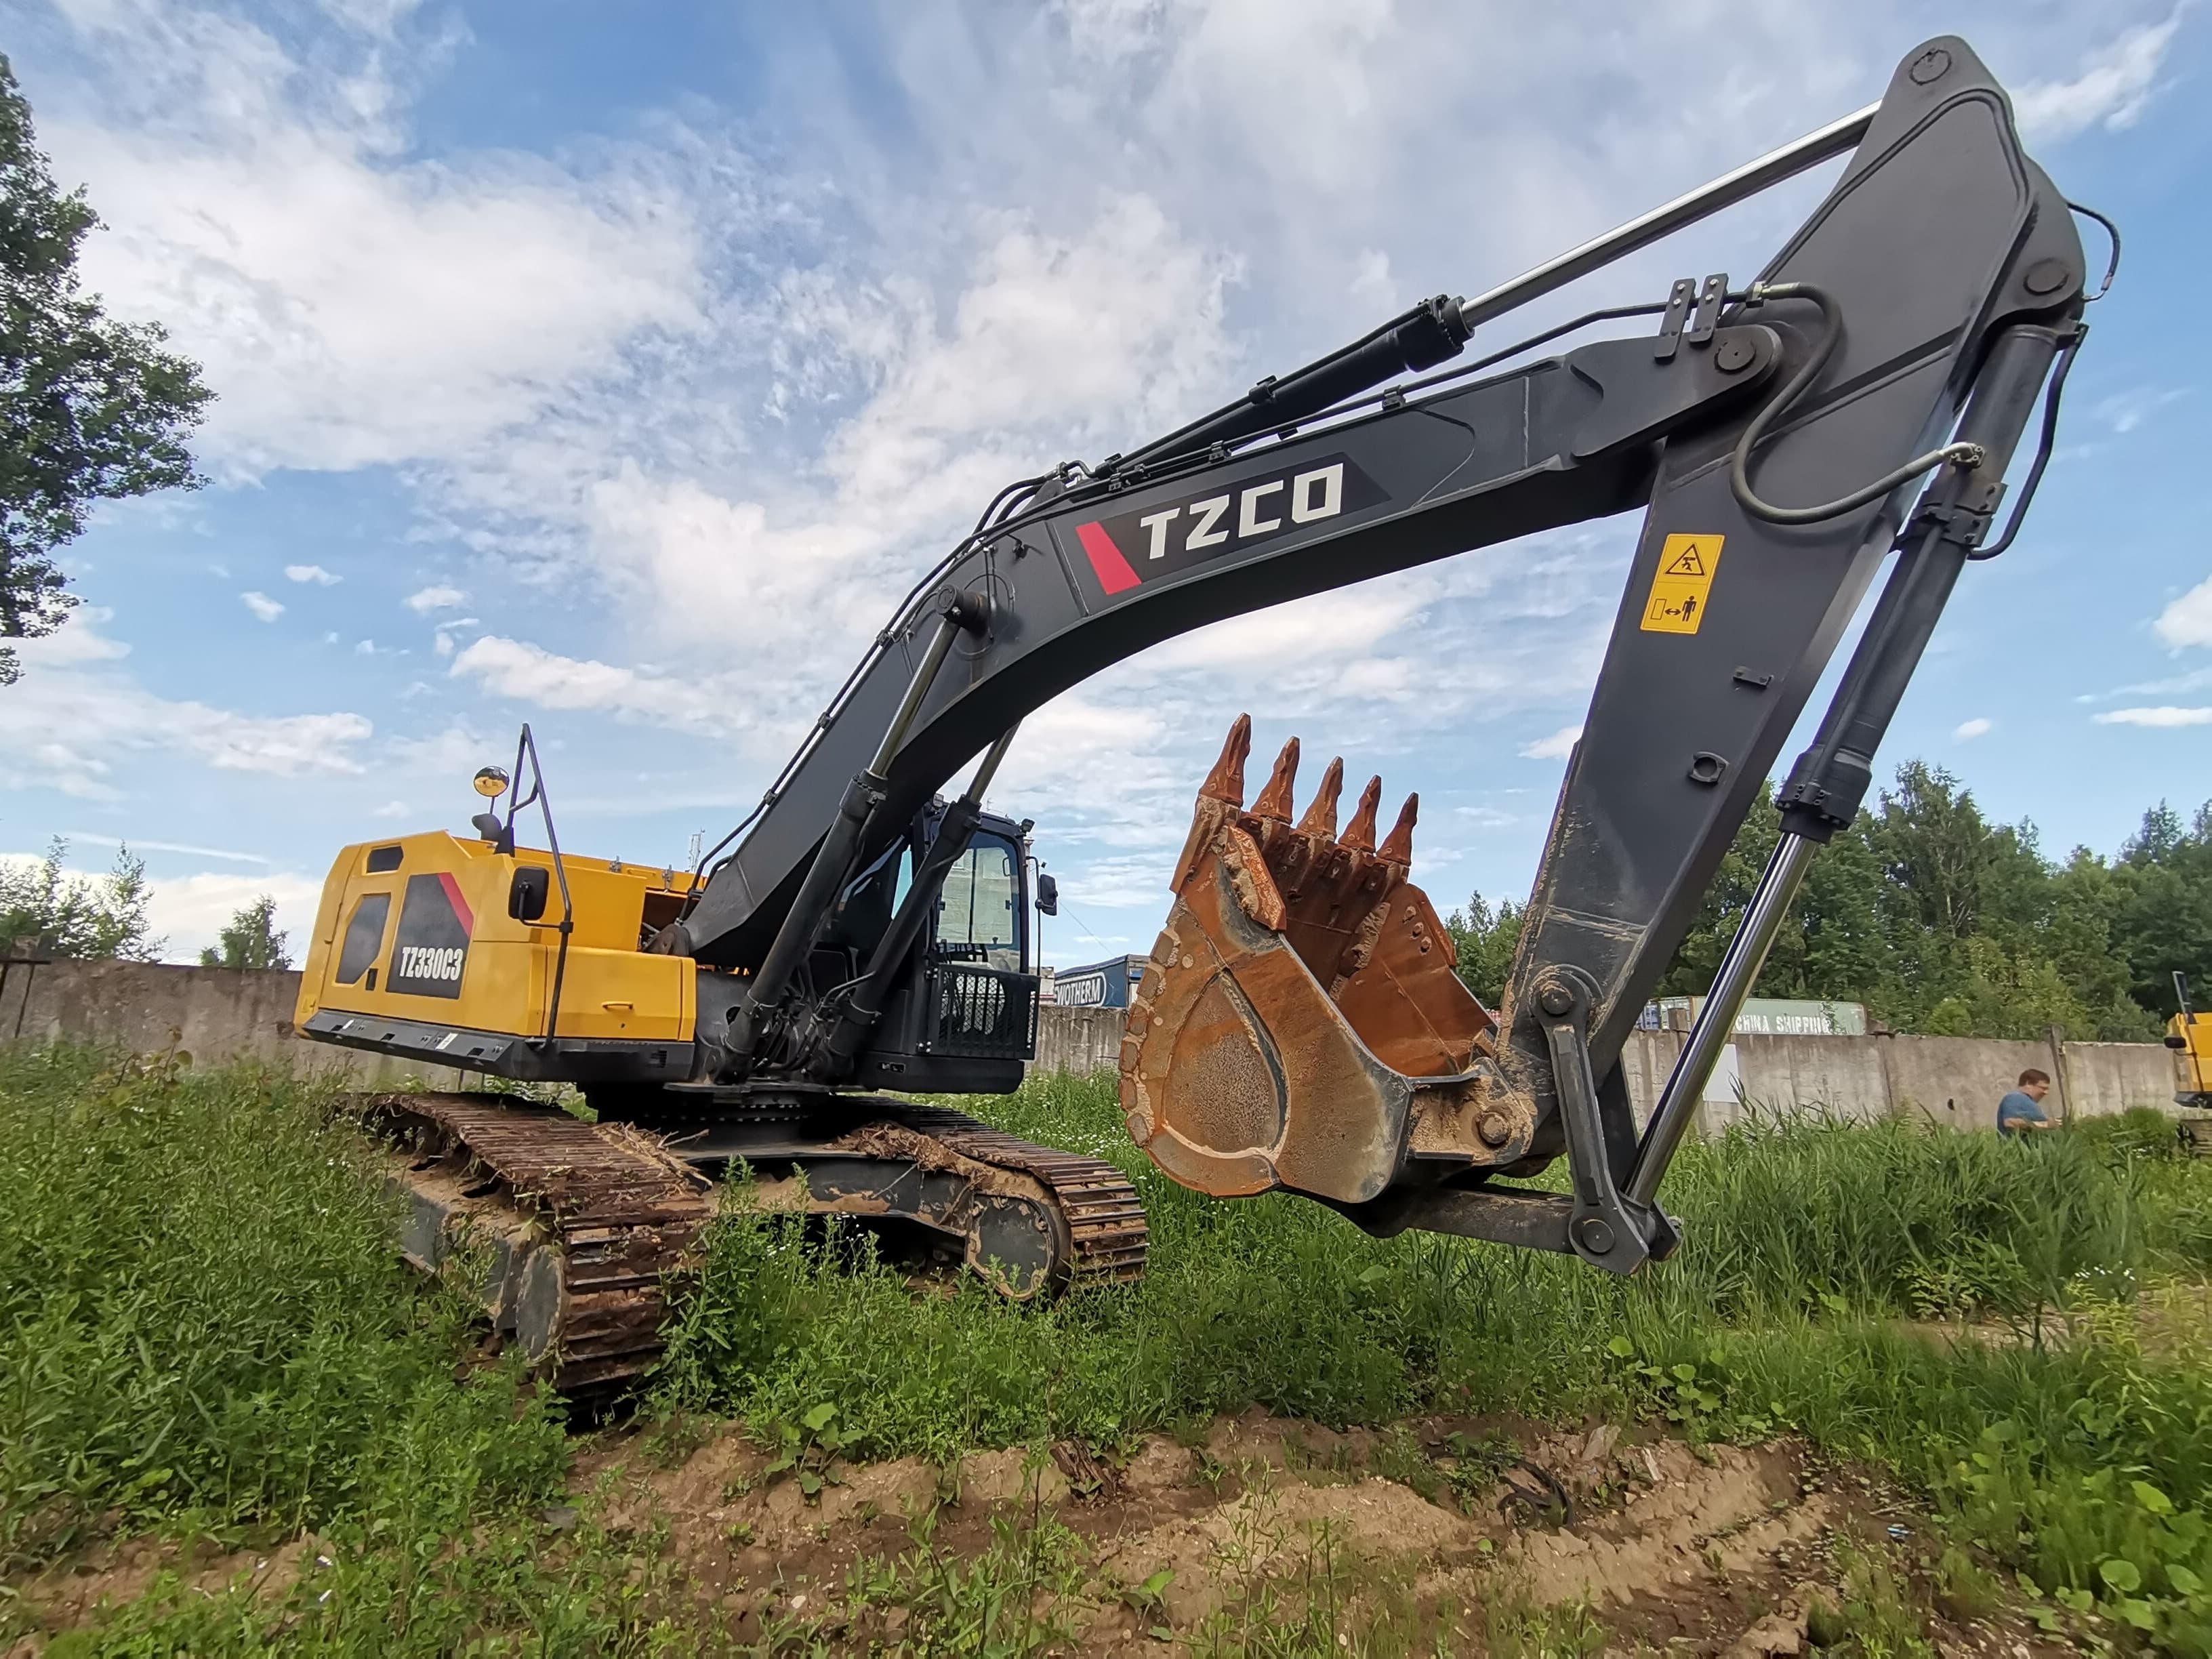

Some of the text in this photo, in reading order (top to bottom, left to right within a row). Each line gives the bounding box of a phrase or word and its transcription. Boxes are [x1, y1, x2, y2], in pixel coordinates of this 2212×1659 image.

[1140, 462, 1344, 560] TZCO
[400, 946, 464, 981] TZ330C3
[1735, 1015, 1830, 1034] CHINA SHIPPING
